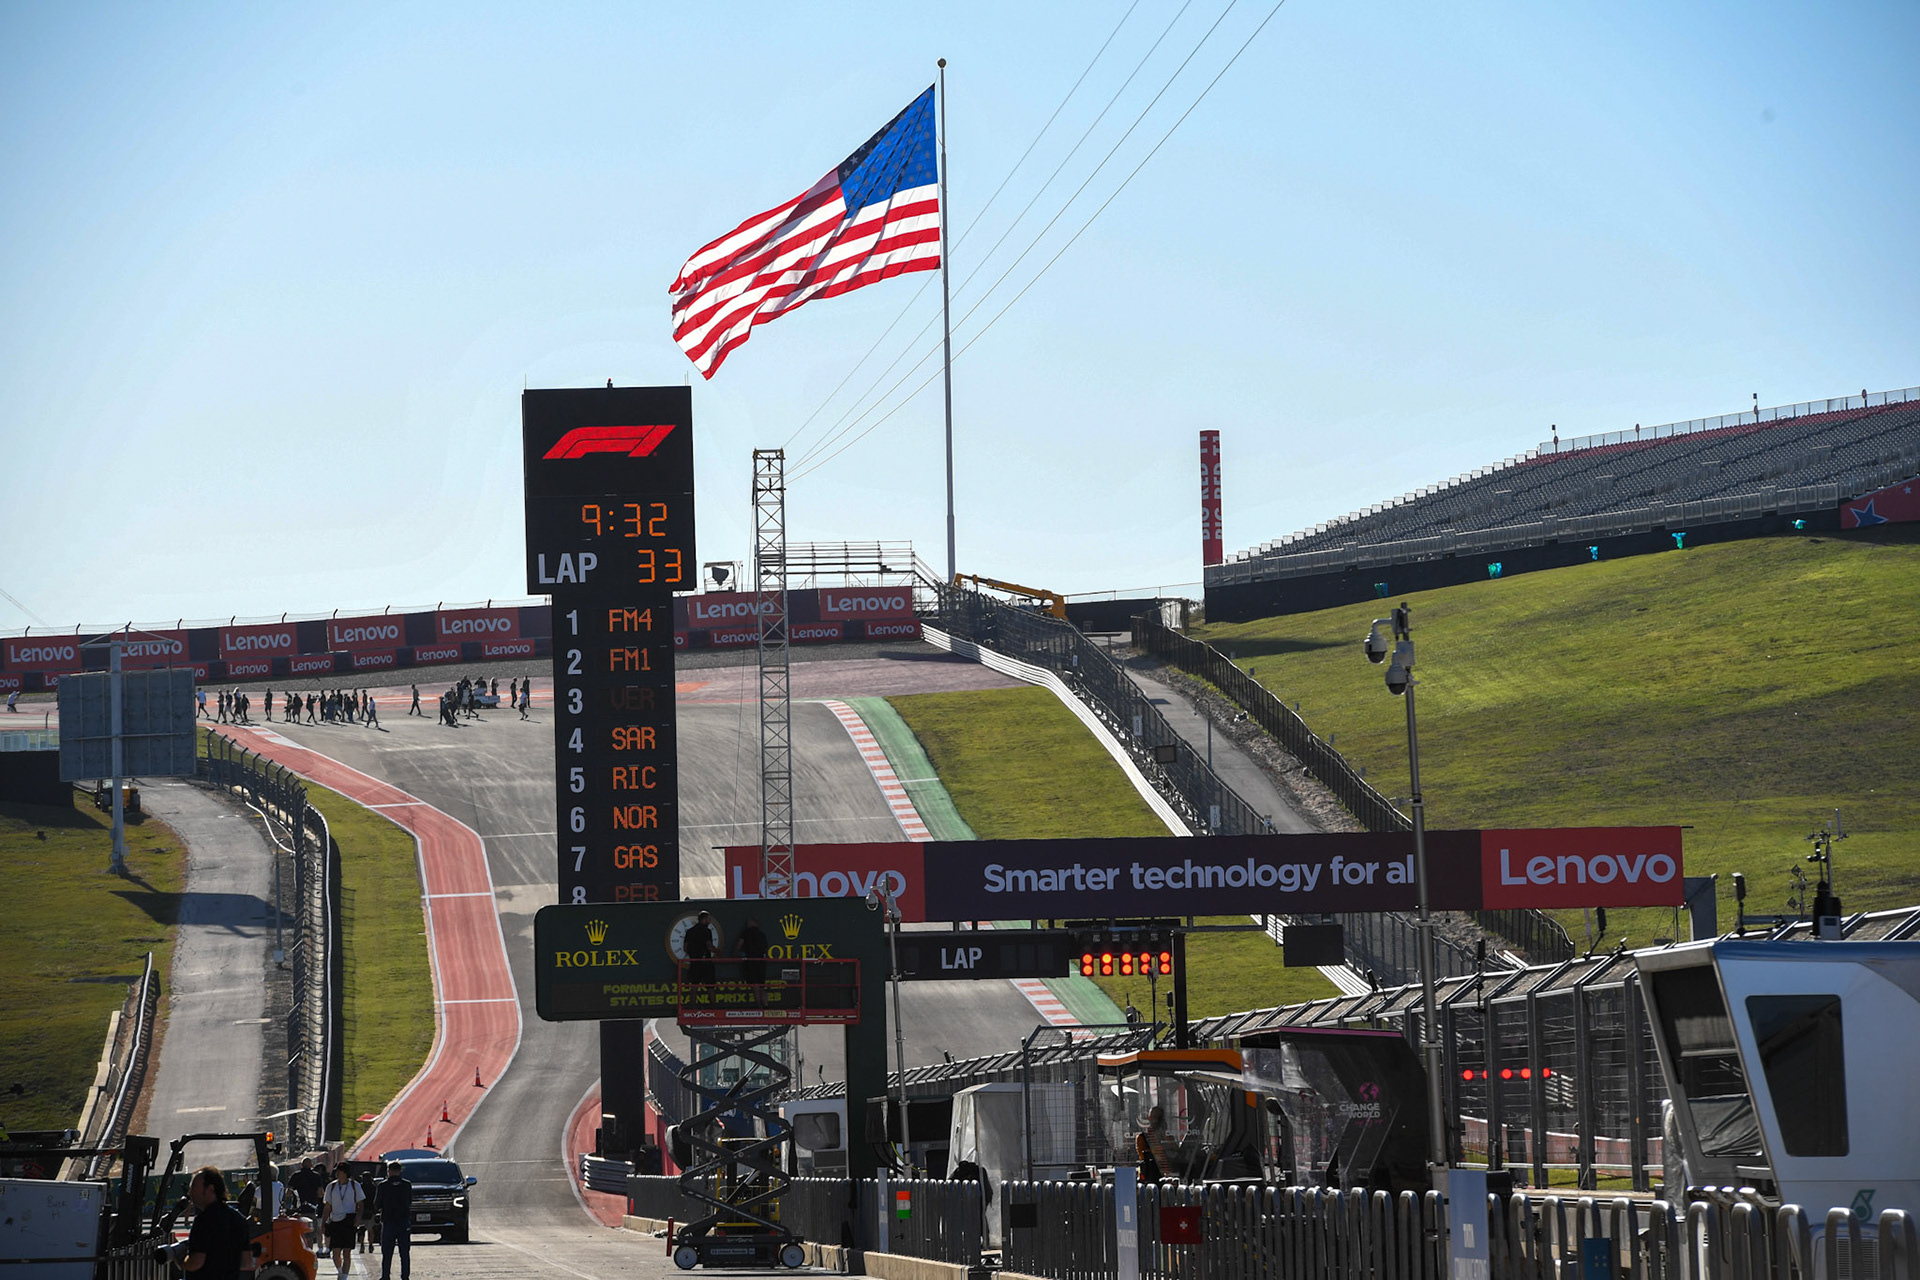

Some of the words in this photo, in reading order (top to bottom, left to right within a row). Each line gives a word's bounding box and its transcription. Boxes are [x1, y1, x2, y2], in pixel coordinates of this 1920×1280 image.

[582, 503, 667, 537] 9:32
[538, 552, 598, 584] LAP
[638, 549, 682, 583] 33
[696, 601, 775, 619] Lenovo
[827, 595, 905, 613] Lenovo
[441, 617, 511, 635] Lenovo
[566, 609, 578, 635] 1
[609, 608, 652, 632] FM4
[868, 624, 914, 636] Lenovo
[225, 633, 291, 651] Lenovo
[334, 625, 399, 644] Lenovo
[713, 631, 760, 644] Lenovo
[791, 627, 839, 639] Lenovo
[10, 645, 75, 663] Lenovo
[416, 648, 458, 661] Lenovo
[485, 643, 530, 656] Lenovo
[229, 662, 269, 675] Lenovo
[291, 659, 331, 672] Lenovo
[354, 653, 393, 667] Lenovo
[567, 649, 582, 675] 2
[610, 648, 651, 672] FM1
[568, 688, 583, 714] 3
[568, 728, 584, 754] 4
[612, 727, 655, 750] SAR
[570, 767, 585, 793] 5
[613, 766, 656, 790] RIC
[570, 806, 585, 833] 6
[614, 805, 657, 829] NOR
[571, 846, 586, 872] 7
[615, 845, 658, 869] GAS
[1500, 848, 1676, 885] Lenovo
[733, 865, 907, 900] Lenovo
[983, 863, 1120, 893] Smarter
[1130, 857, 1322, 892] technology
[1330, 855, 1379, 885] for
[1386, 854, 1415, 885] al
[572, 886, 587, 904] 8
[615, 884, 659, 903] PER
[555, 949, 640, 968] ROLEX
[767, 943, 833, 960] OLEX
[940, 947, 982, 969] LAP
[603, 983, 669, 994] FORMULA
[610, 996, 664, 1007] STATES
[716, 992, 746, 1004] PRIX
[1340, 1103, 1380, 1112] CHANGE
[1349, 1111, 1381, 1119] WORLD
